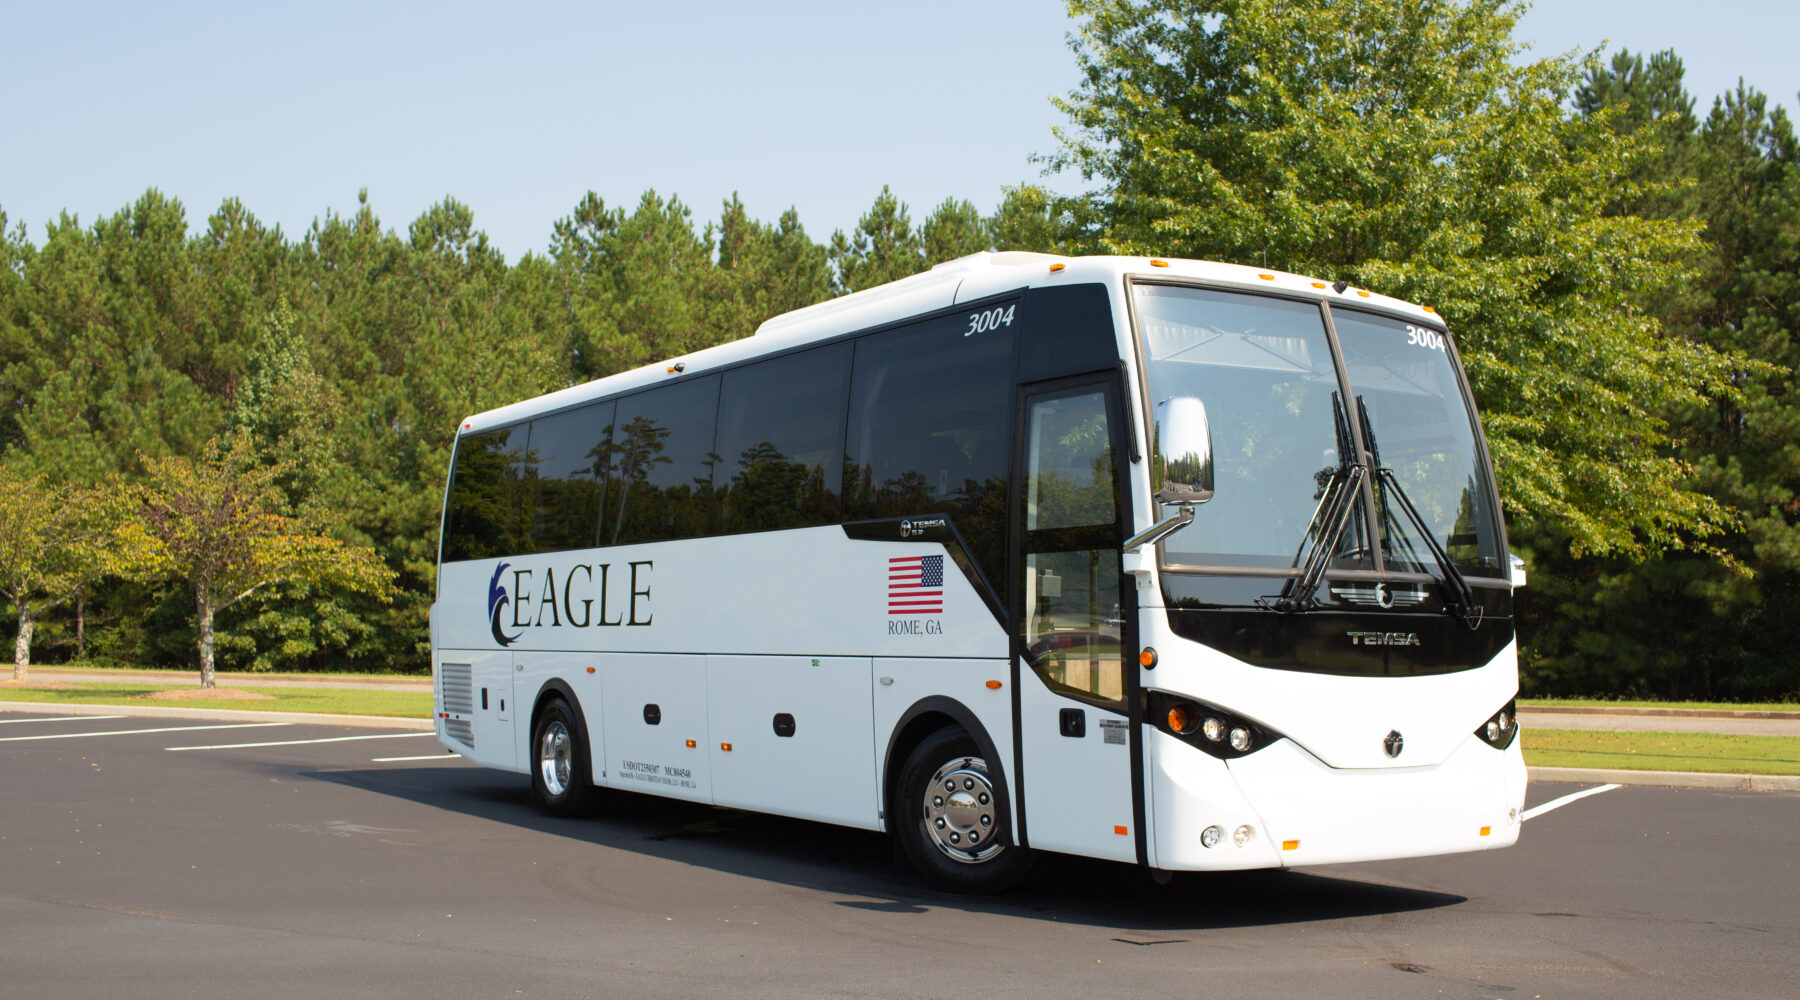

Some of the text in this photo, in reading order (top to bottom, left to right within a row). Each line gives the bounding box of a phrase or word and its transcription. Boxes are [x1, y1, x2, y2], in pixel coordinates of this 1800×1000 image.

[963, 304, 1016, 337] 3004
[1406, 325, 1446, 353] 3004
[911, 520, 946, 528] TEMSA
[511, 560, 654, 628] EAGLE
[888, 619, 943, 637] ROME, GA
[1346, 631, 1421, 646] TEMSA
